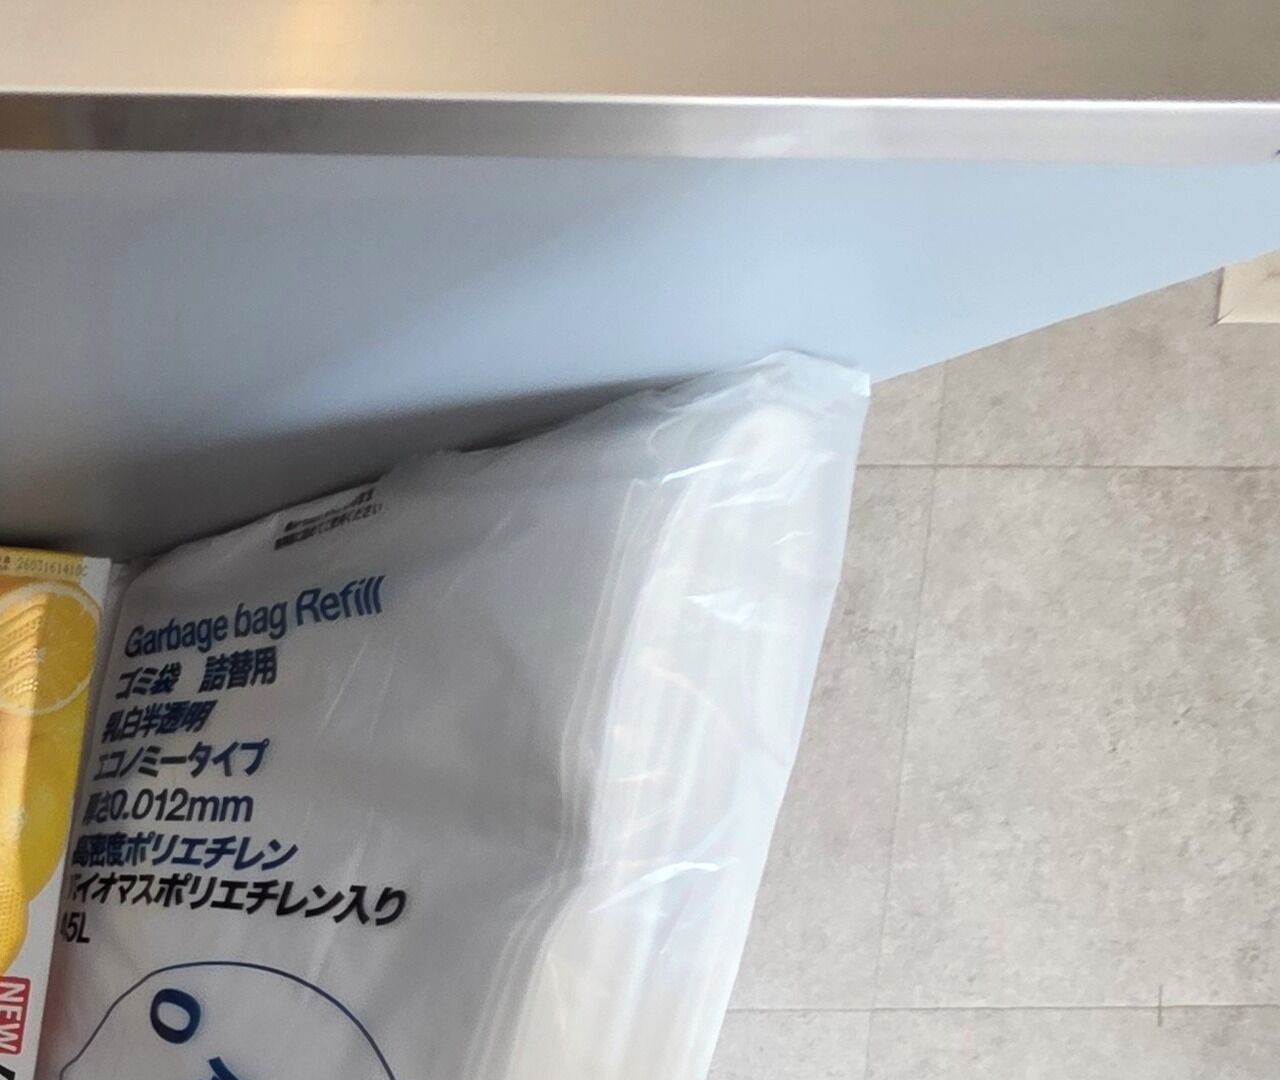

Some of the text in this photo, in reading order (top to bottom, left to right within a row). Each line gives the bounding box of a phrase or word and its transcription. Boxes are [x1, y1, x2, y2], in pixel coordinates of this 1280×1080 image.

[124, 575, 386, 658] Garbage bag Refill
[116, 645, 278, 700] ゴミ袋 詰替用
[93, 738, 270, 782] エコノミータイプ
